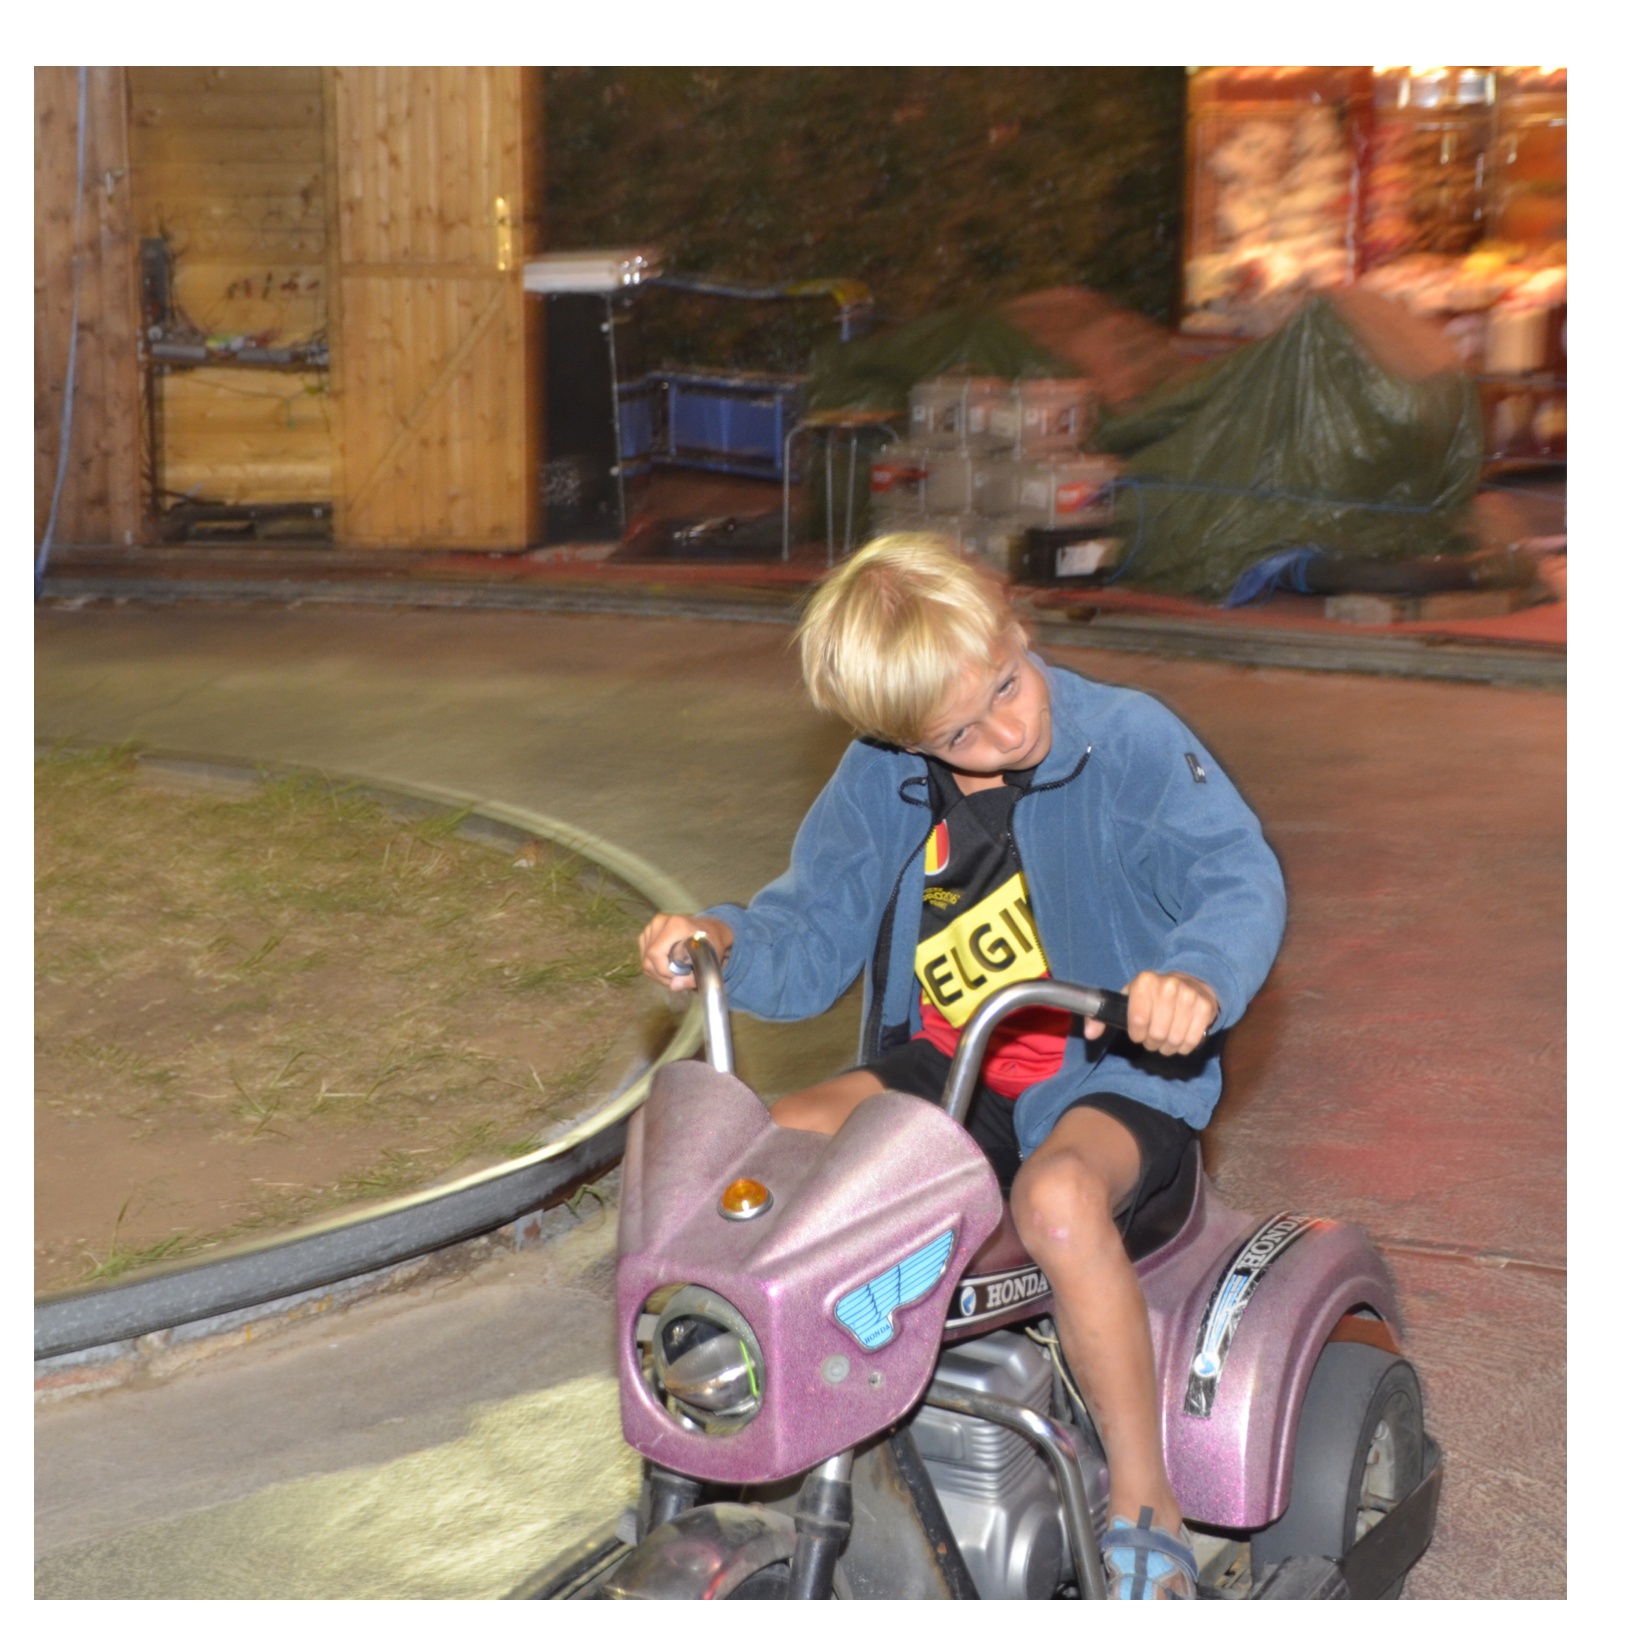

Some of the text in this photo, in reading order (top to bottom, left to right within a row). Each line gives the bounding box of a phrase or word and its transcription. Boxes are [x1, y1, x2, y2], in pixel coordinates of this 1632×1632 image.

[1238, 1215, 1313, 1272] HONDA
[986, 1271, 1049, 1309] HONDA
[864, 1323, 891, 1345] HONDA
